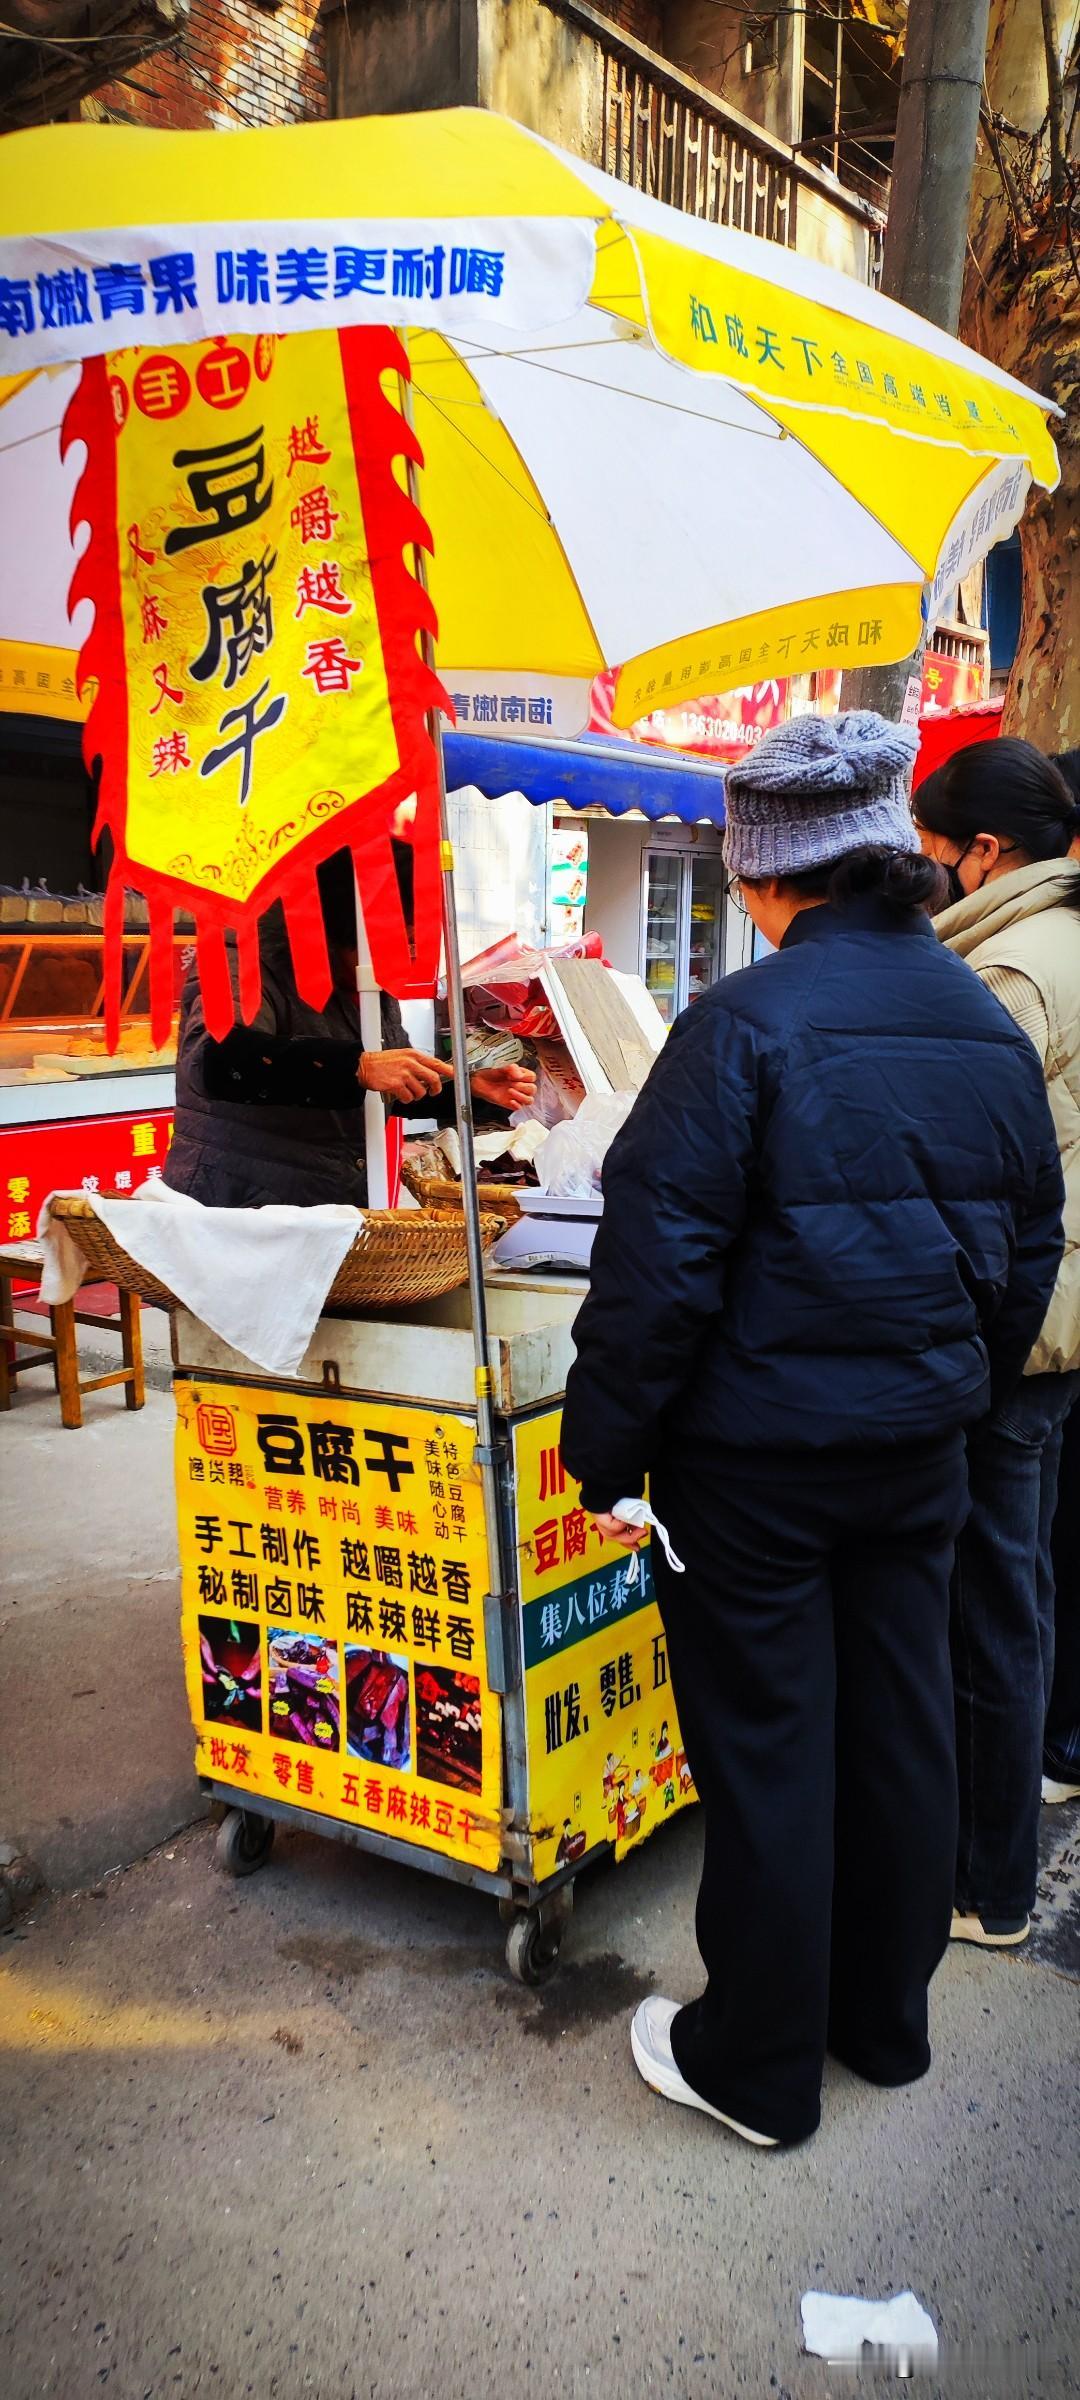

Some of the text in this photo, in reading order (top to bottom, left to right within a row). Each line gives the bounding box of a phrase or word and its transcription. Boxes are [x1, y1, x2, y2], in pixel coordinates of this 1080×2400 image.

[215, 246, 505, 305] 味美更耐嚼
[689, 294, 823, 376] 和成天下
[286, 414, 361, 694] 越嚼越香
[127, 522, 192, 778] 又麻又辣
[164, 424, 286, 806] 豆腐干
[130, 1122, 174, 1157] 重
[256, 1413, 415, 1493] 豆腐干
[424, 1439, 450, 1540] 美味随心动
[443, 1441, 468, 1543] 特色豆腐干
[264, 1485, 418, 1536] 营养 时尚 美味
[195, 1515, 472, 1604] 手工制作 越嚼越香
[198, 1565, 475, 1661] 秘制卤味 麻辣鲜香
